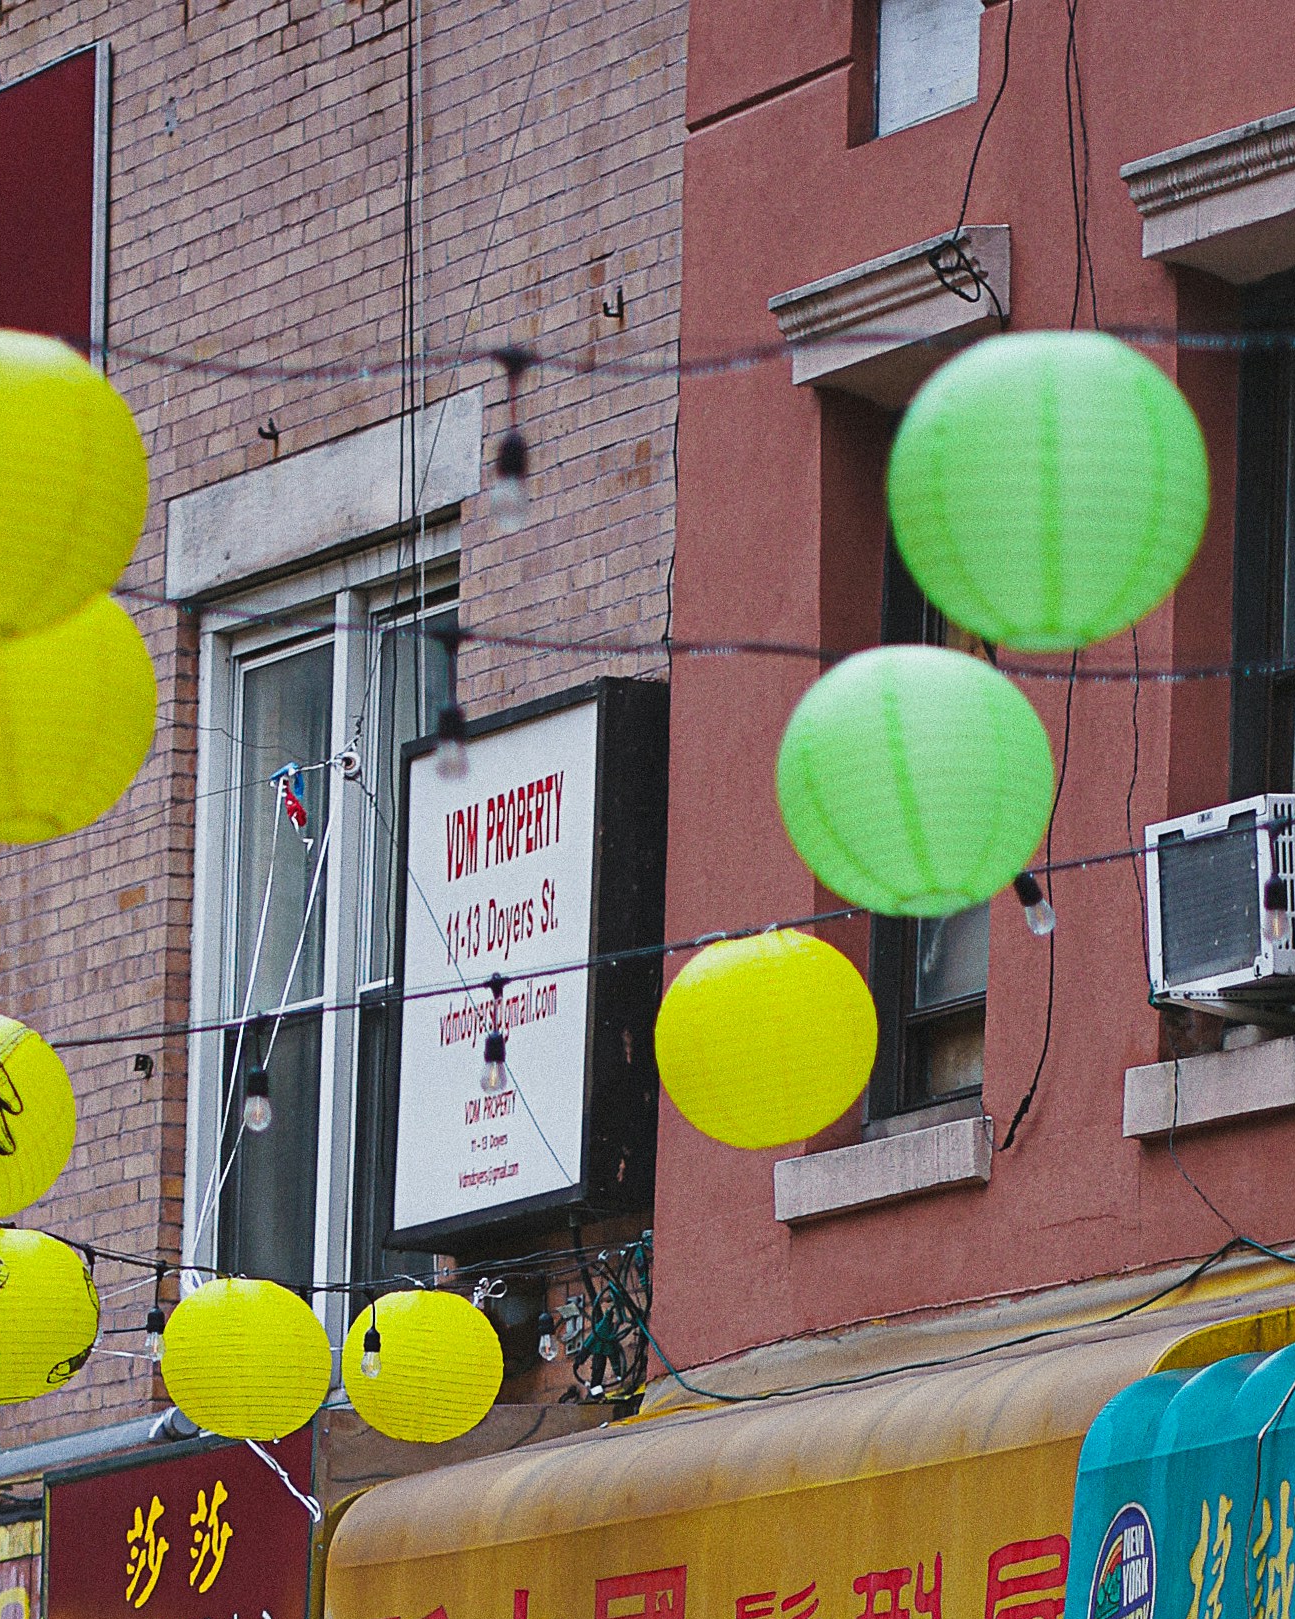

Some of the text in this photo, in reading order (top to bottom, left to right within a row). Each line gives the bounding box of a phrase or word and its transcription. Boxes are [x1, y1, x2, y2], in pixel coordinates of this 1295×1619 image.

[446, 771, 565, 882] VDM PROPERTY
[446, 878, 559, 966] 11-13 Doyers St.
[126, 1480, 233, 1609] 莎莎
[1121, 1521, 1150, 1559] NEW
[1121, 1556, 1151, 1602] YORK
